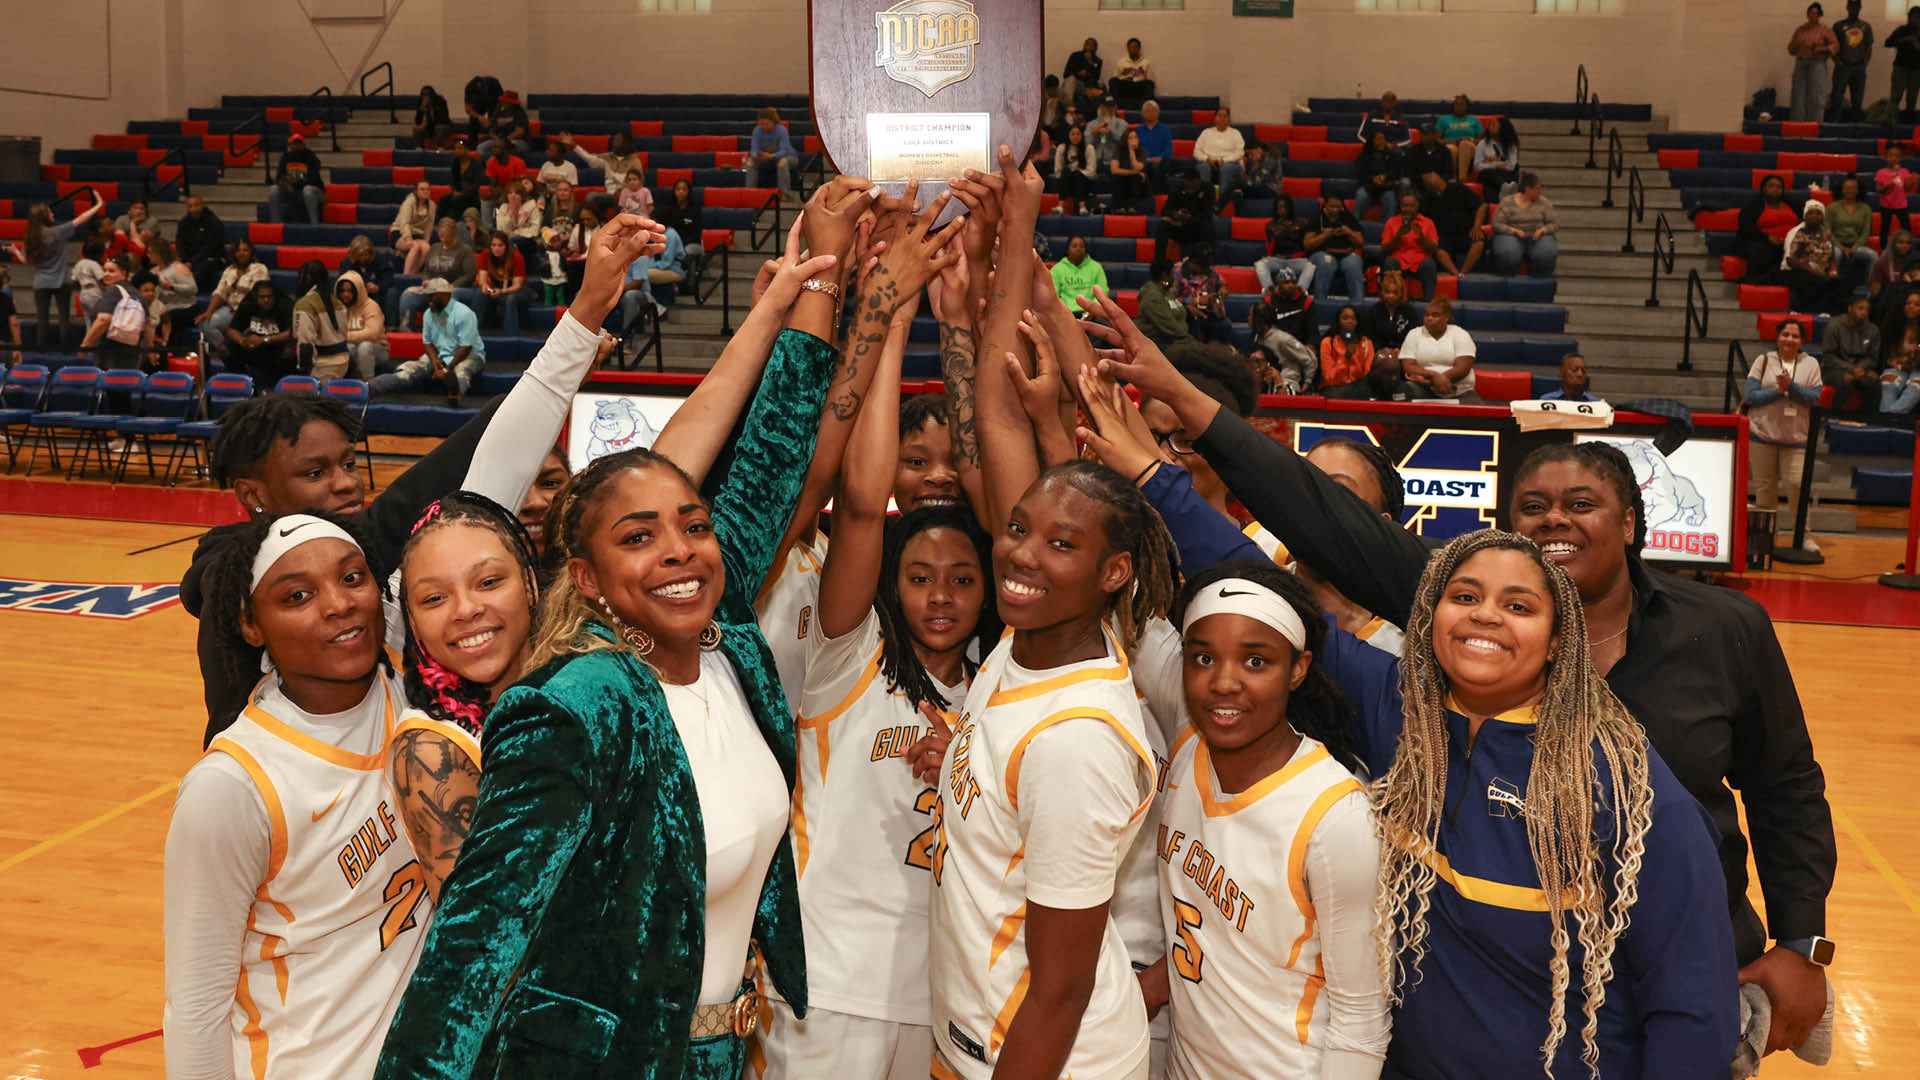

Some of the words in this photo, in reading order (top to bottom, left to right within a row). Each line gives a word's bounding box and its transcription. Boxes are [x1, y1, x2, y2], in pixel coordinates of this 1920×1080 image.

[879, 15, 976, 61] NJCAA
[927, 124, 971, 132] CHAMPION
[1401, 479, 1486, 498] OAST
[1646, 530, 1718, 558] DOGS
[337, 800, 398, 889] GULF
[1182, 839, 1255, 933] COAST
[1172, 895, 1204, 984] 5
